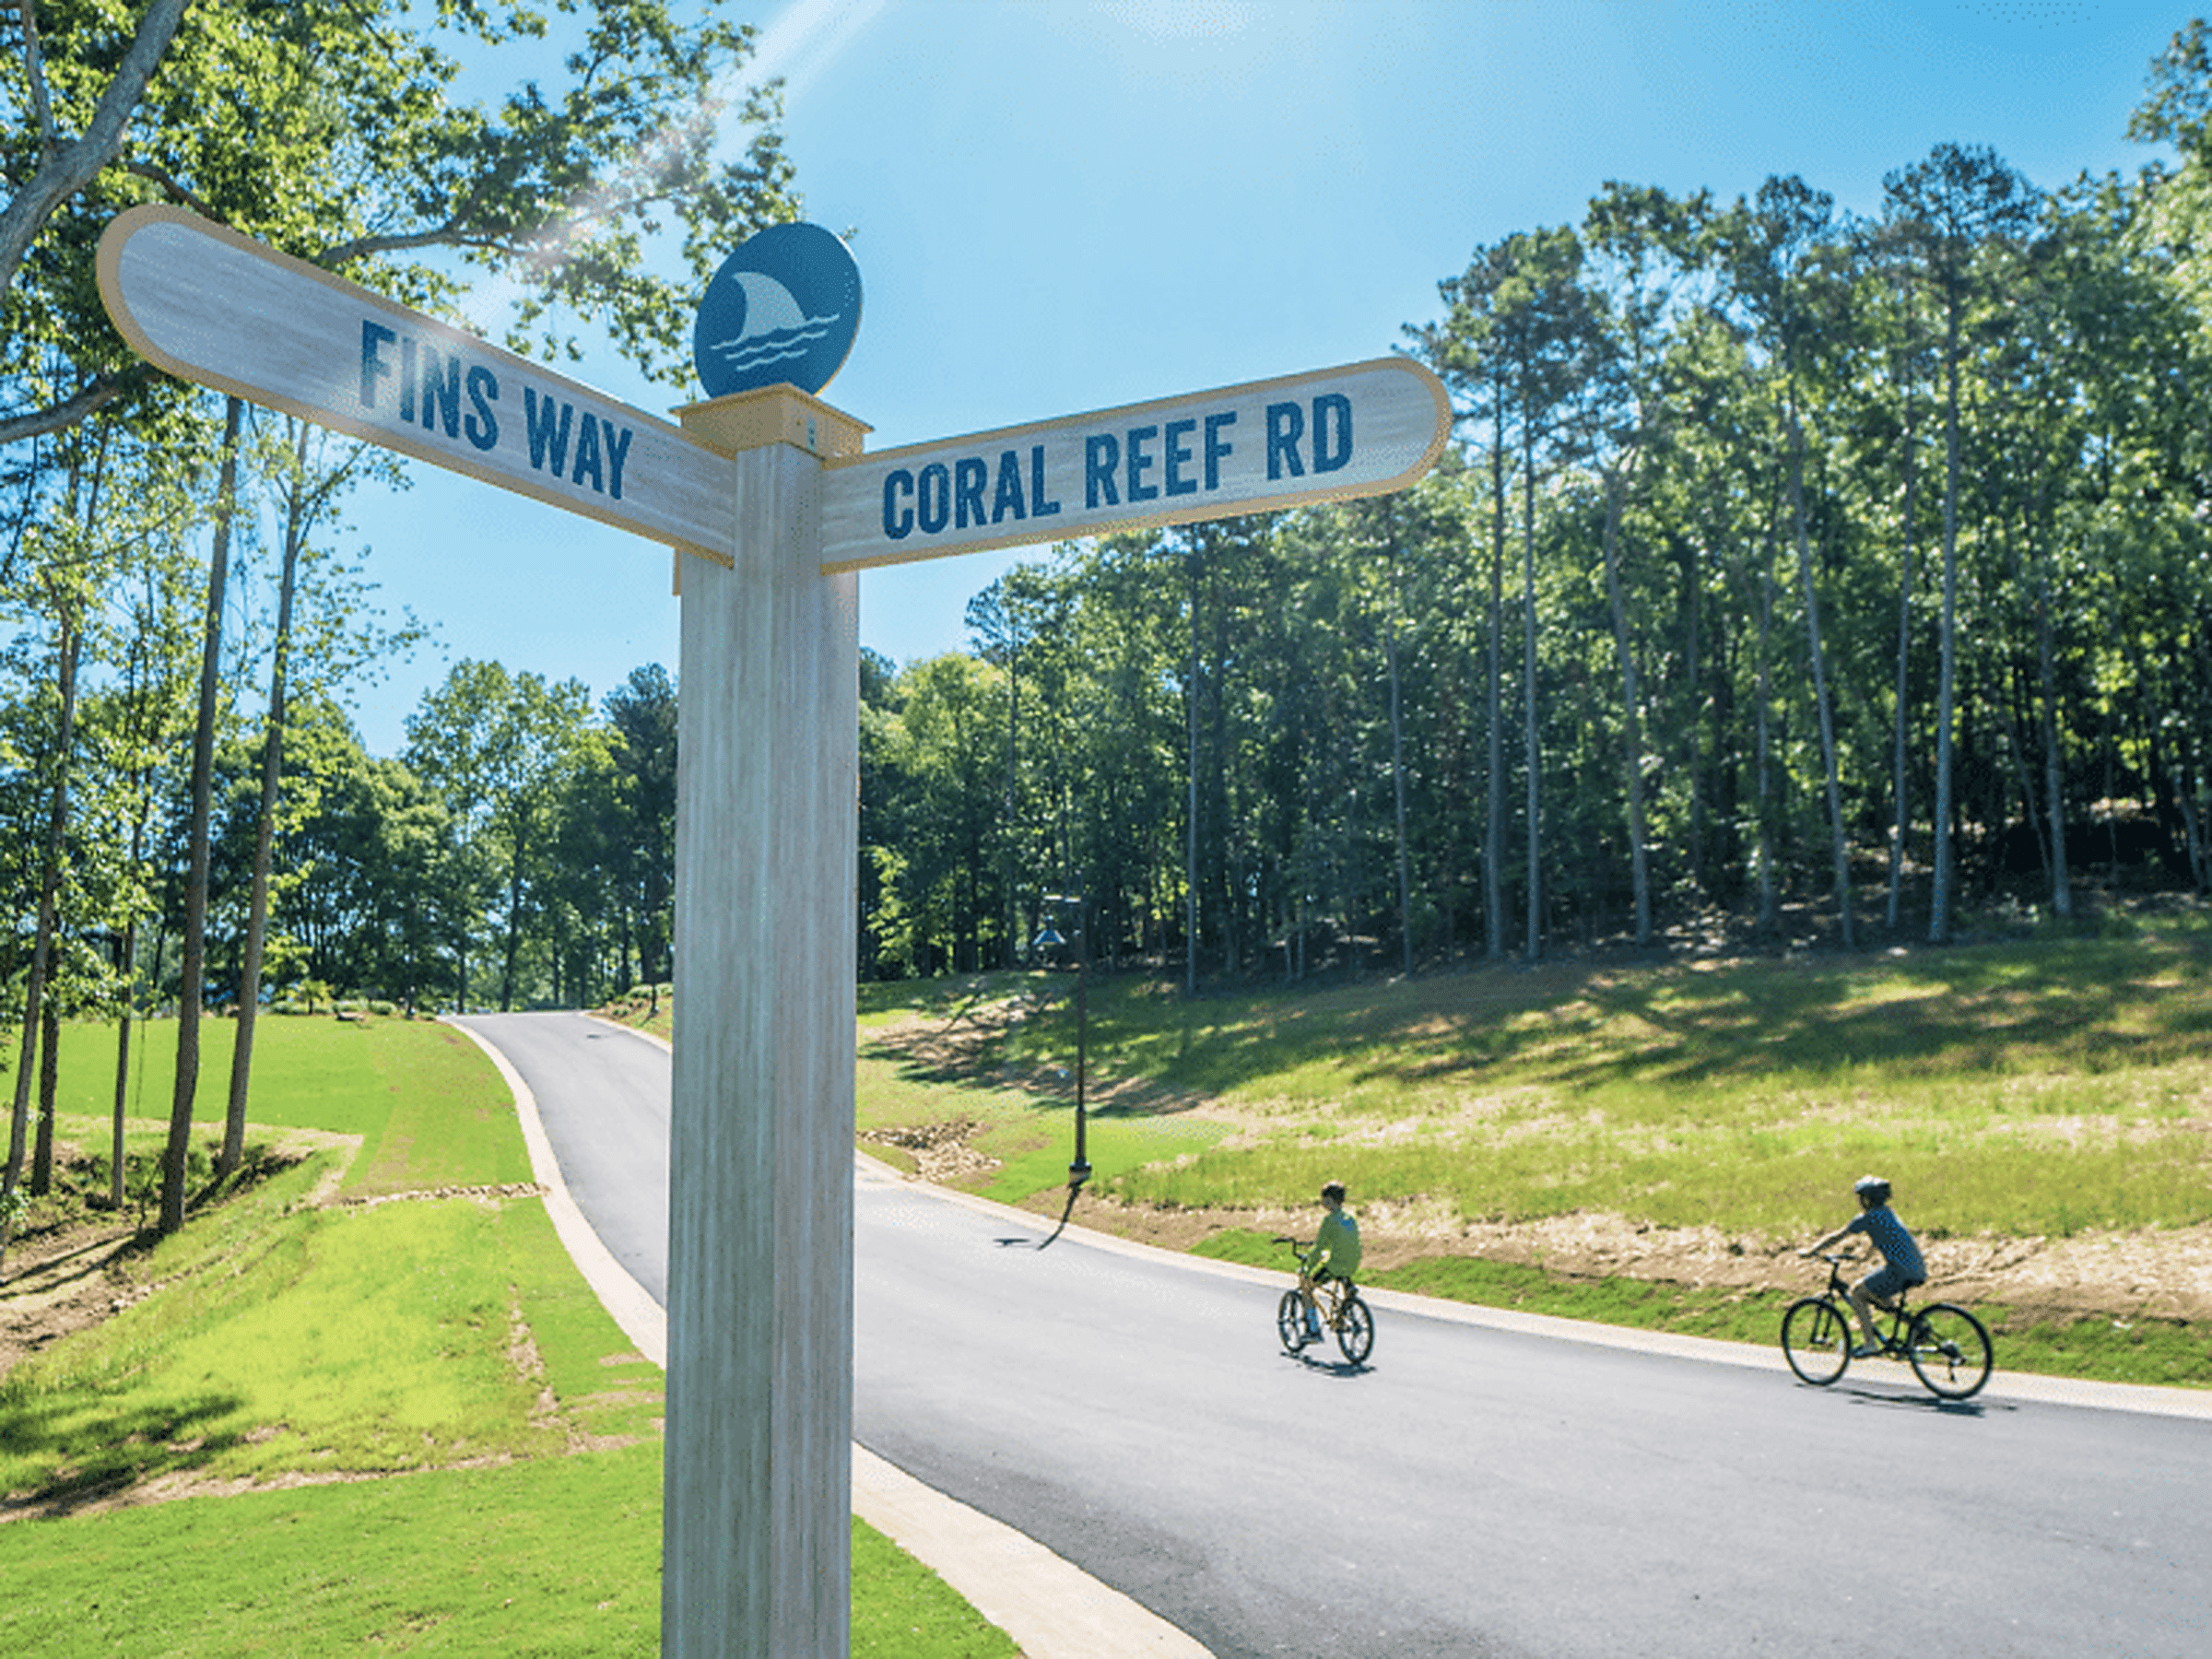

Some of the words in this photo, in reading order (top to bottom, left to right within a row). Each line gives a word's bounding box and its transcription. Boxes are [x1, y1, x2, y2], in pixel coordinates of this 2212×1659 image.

[359, 318, 500, 452] FINS
[524, 385, 633, 500] WAY
[882, 444, 1061, 540] CORAL
[1085, 411, 1237, 510] REEF
[1266, 393, 1353, 481] RD
